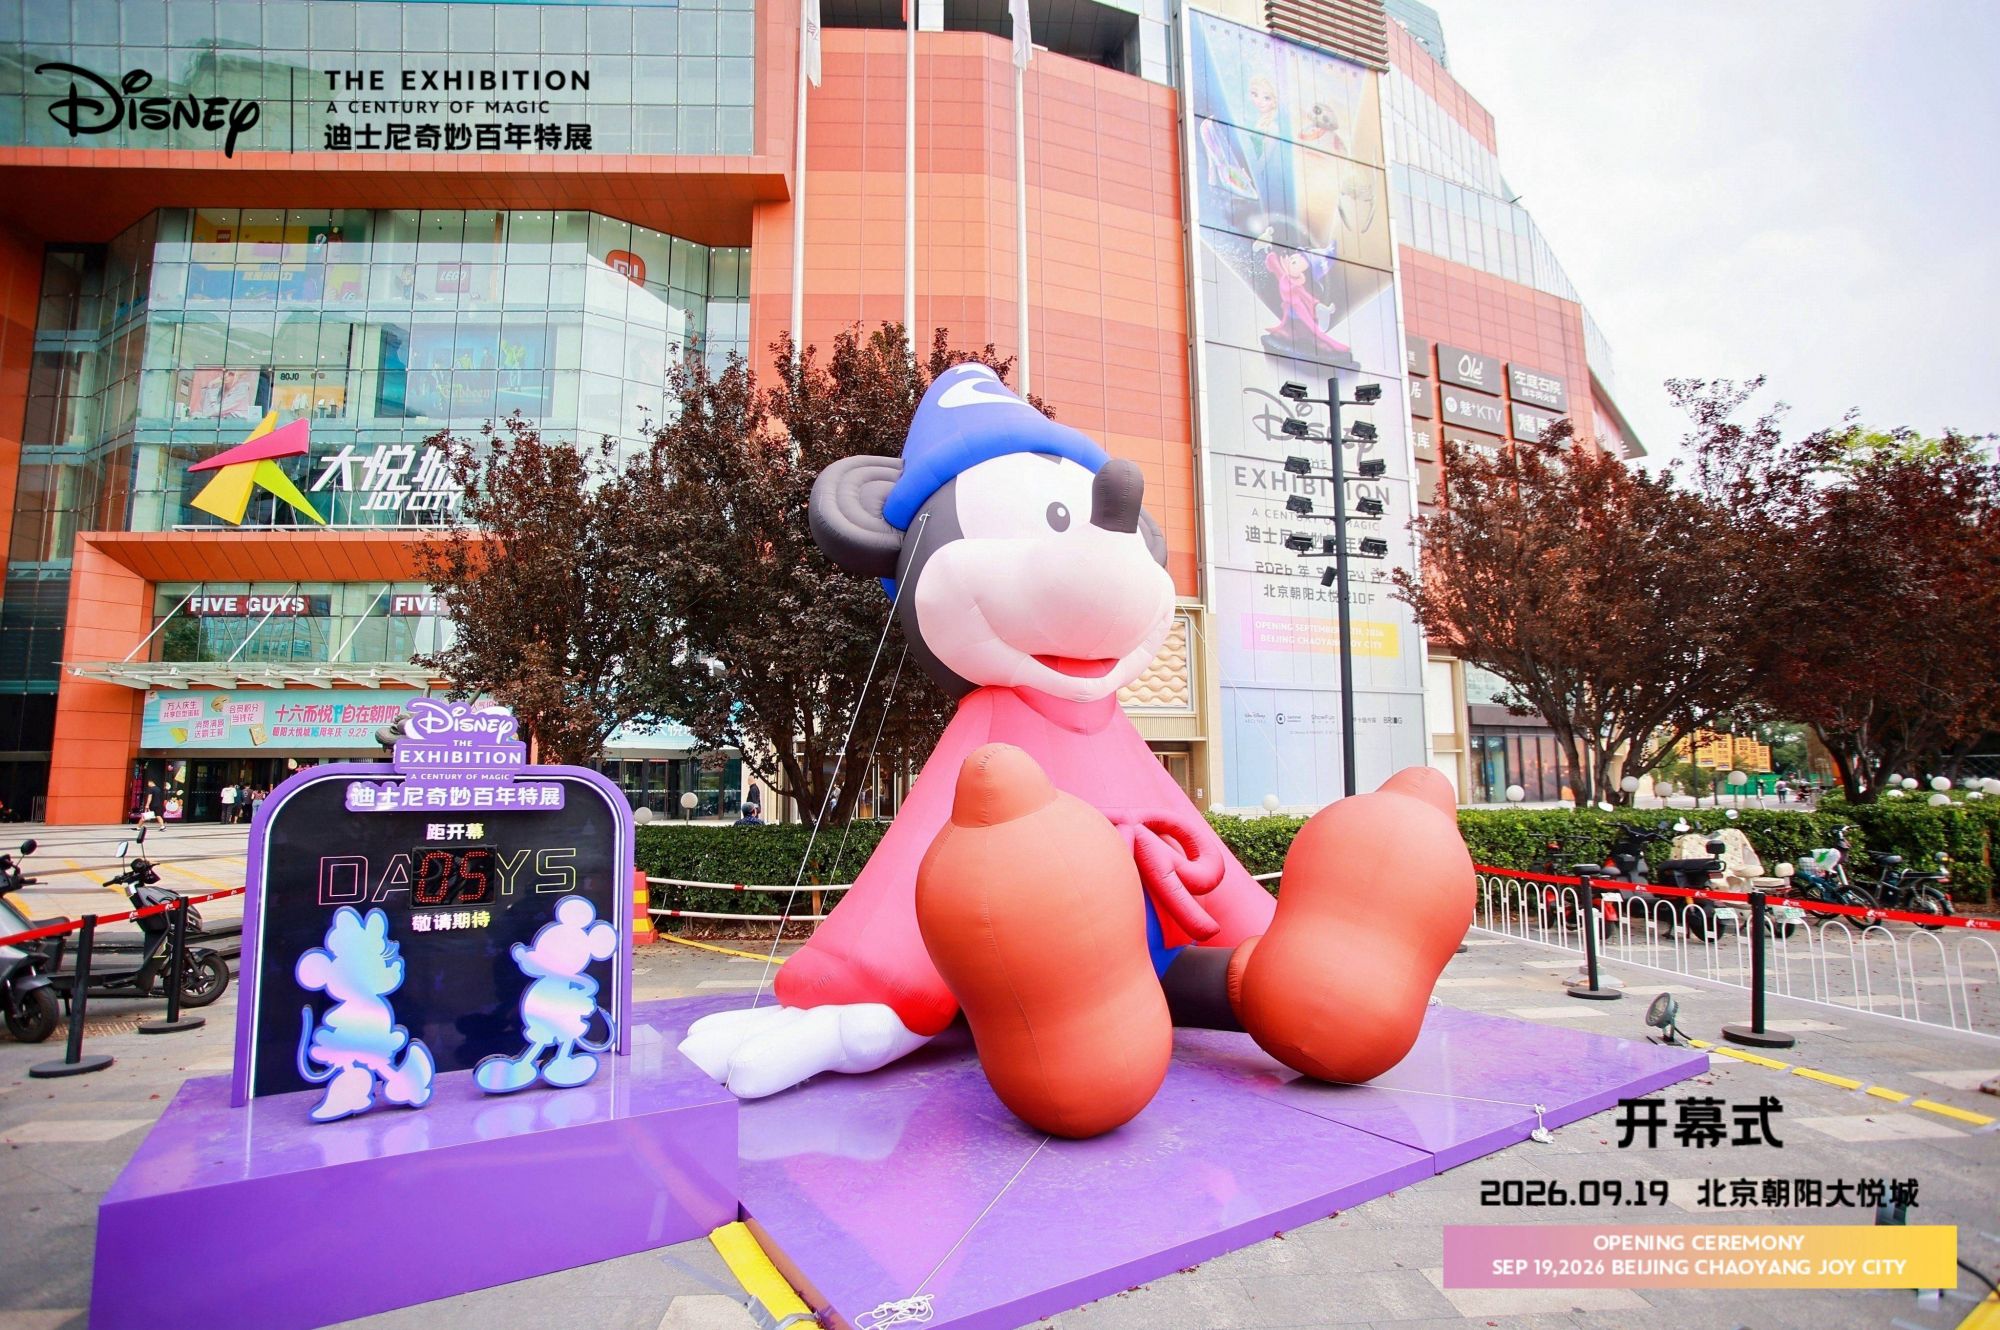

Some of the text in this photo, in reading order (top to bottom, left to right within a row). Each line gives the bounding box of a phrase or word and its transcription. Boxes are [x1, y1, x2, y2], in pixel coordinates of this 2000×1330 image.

[440, 271, 467, 281] LEGO
[1235, 465, 1390, 506] EXHIBIION
[360, 491, 463, 510] JOY CITY
[190, 597, 305, 612] FIVE GUYS
[395, 597, 441, 612] FIVE
[400, 750, 521, 764] EXHIBITION
[351, 787, 560, 806] 迪士尼奇妙百年特展
[426, 823, 485, 841] 距开幕
[411, 911, 490, 932] 敬请期待
